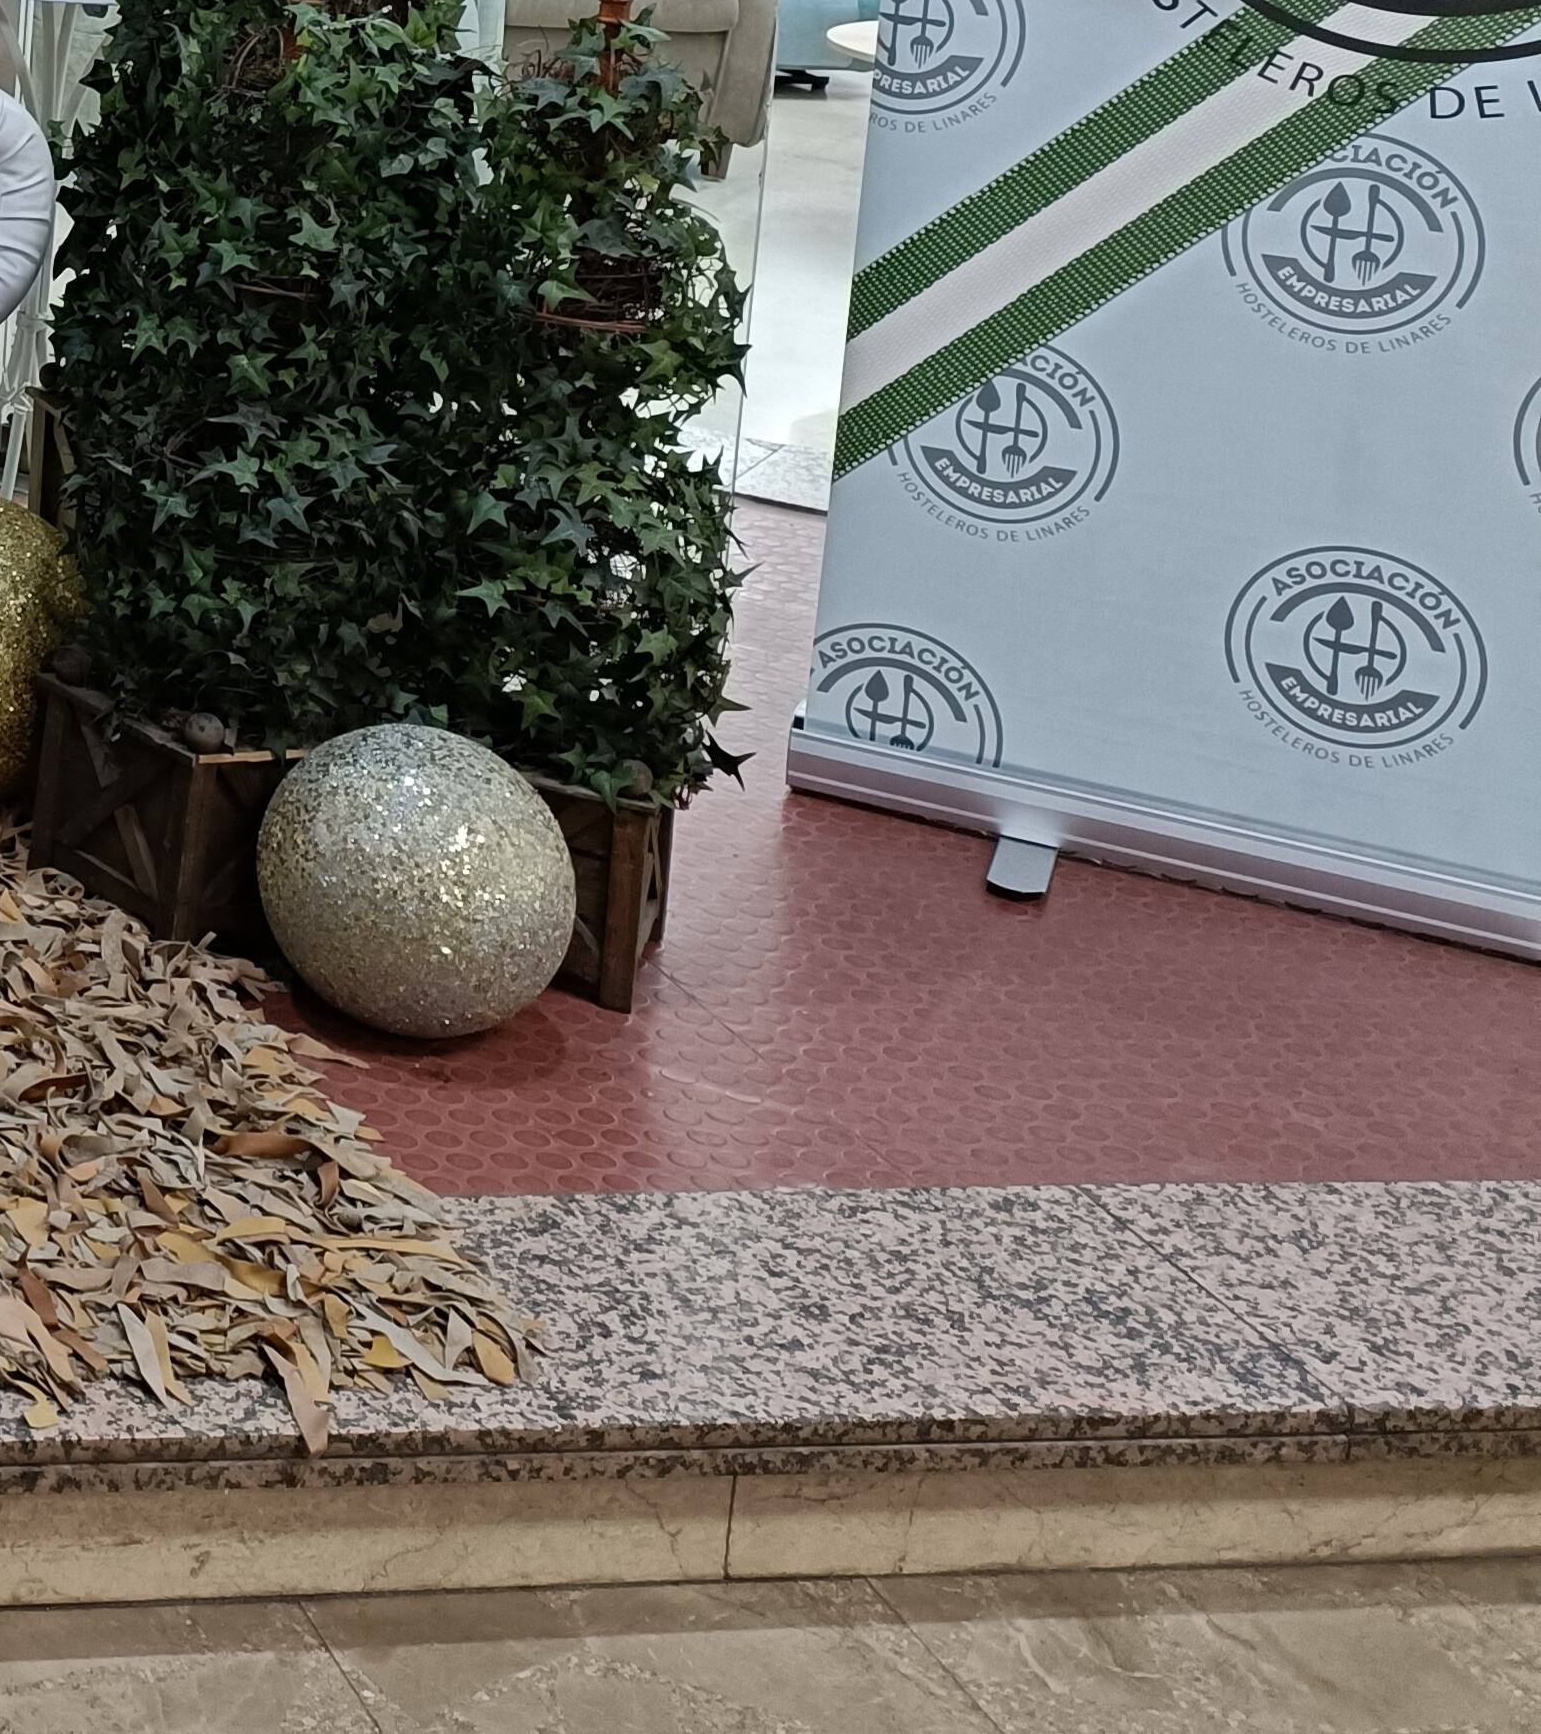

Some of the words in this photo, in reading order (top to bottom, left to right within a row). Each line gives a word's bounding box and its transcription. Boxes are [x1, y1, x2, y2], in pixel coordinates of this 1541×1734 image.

[904, 120, 926, 134] DE
[933, 91, 997, 132] LINARES
[1429, 84, 1506, 120] DE
[1235, 282, 1337, 352] HOSTELEROS
[1345, 340, 1371, 355] DE
[1379, 312, 1452, 354] LINARES
[1277, 266, 1422, 314] EMPRESARIAL
[897, 471, 990, 540] HOSTELEROS
[996, 529, 1020, 543] DE
[1025, 505, 1090, 542] LINARES
[934, 457, 1064, 504] EMPRESARIAL
[1271, 558, 1462, 630] ASOCIACIÓN
[817, 635, 981, 702] ASOCIACIÓN
[1238, 689, 1341, 764] HOSTELEROS
[1348, 753, 1374, 769] DE
[1382, 732, 1455, 769] LINARES
[1280, 676, 1424, 728] EMPRESARIAL
